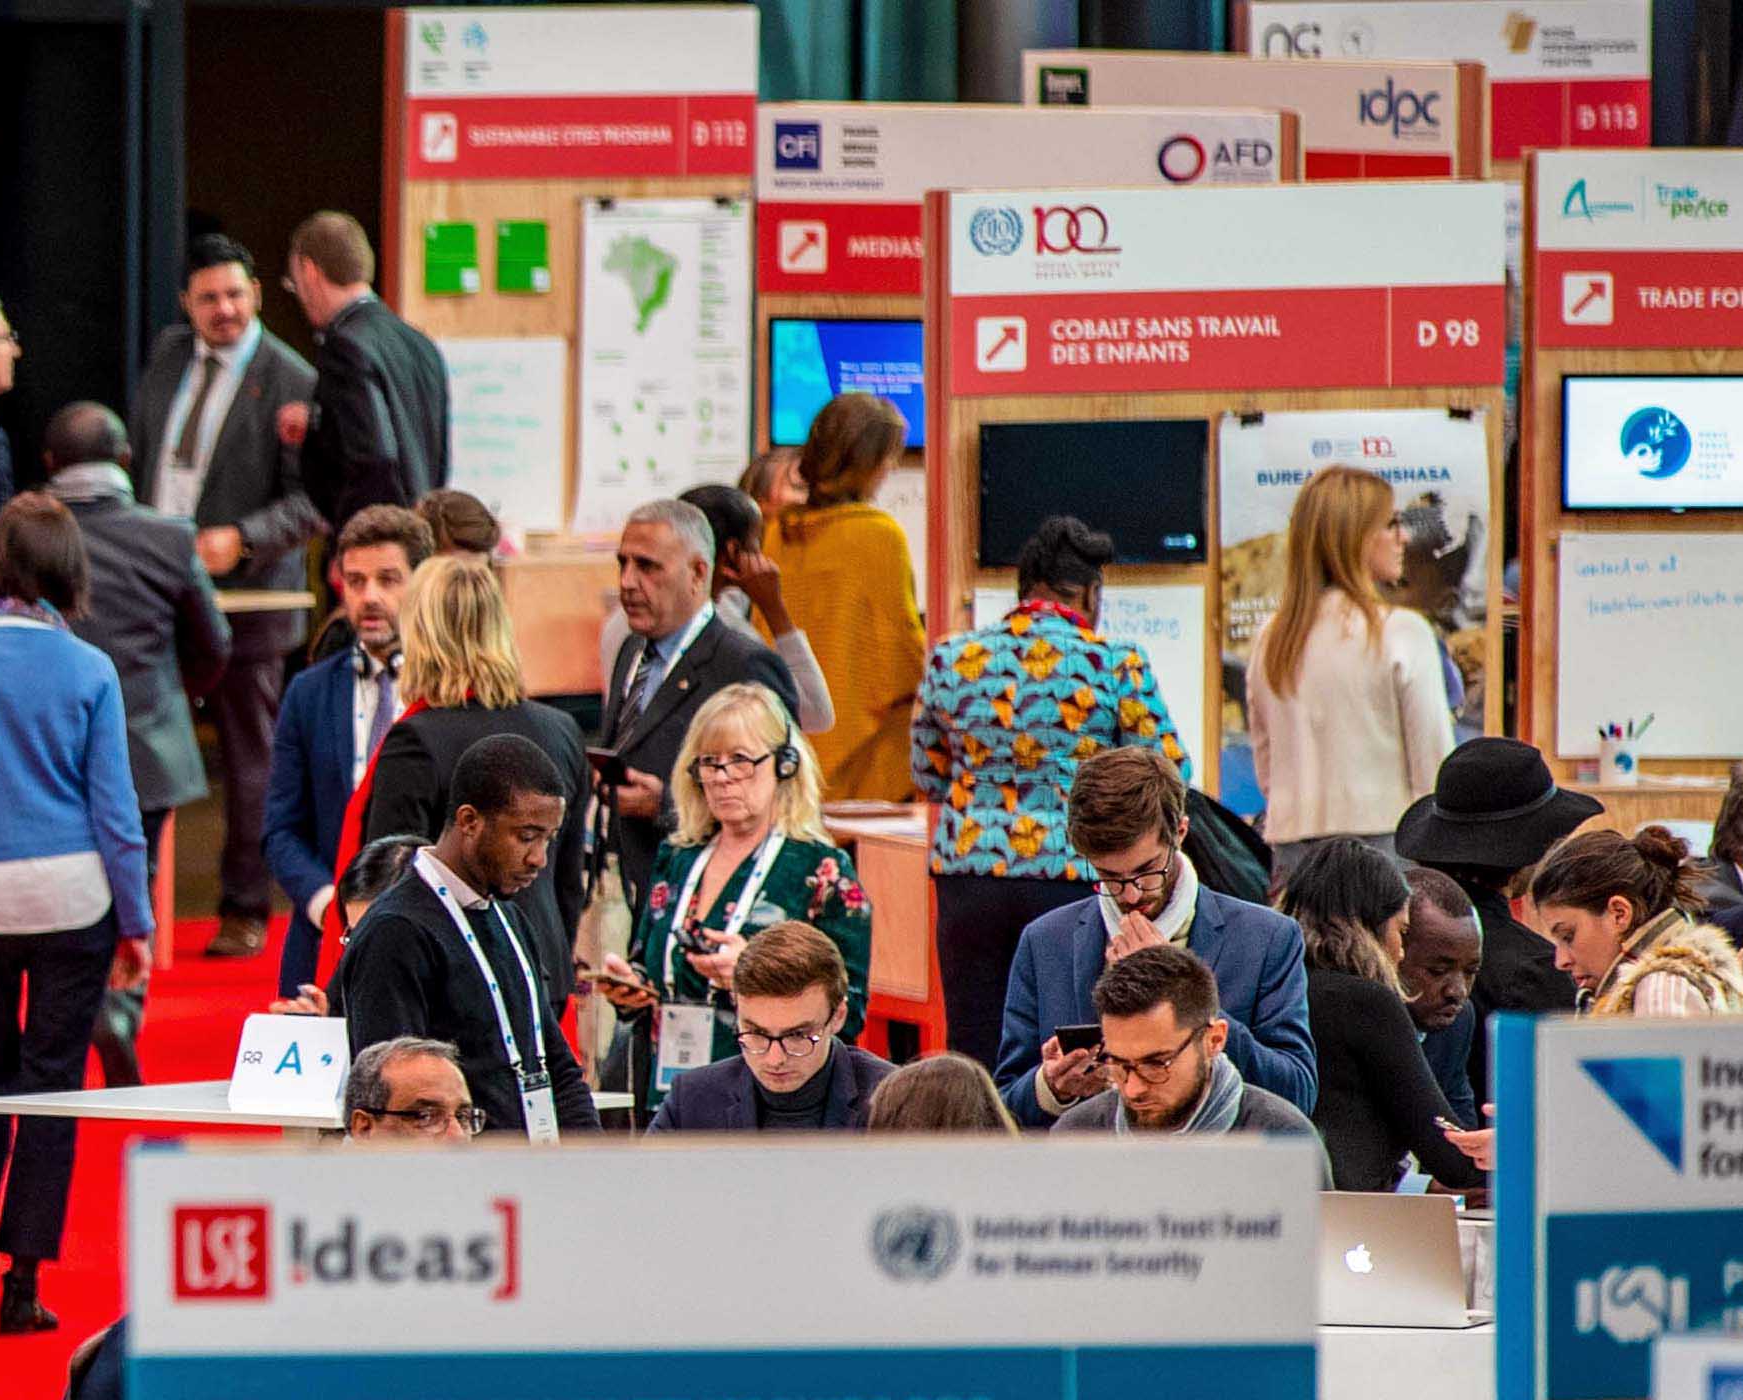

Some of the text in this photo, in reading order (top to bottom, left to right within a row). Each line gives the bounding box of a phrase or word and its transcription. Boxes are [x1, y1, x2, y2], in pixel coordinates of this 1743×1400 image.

[1578, 104, 1639, 131] D 113
[1214, 142, 1273, 168] AFD
[1638, 286, 1743, 309] TRADE FO
[1051, 315, 1281, 342] COBALT SANS TRAVAIL
[1417, 320, 1480, 347] D 98
[1051, 340, 1190, 365] DES ENFANTS
[274, 1041, 303, 1075] A
[1220, 1211, 1282, 1239] Fund
[180, 1213, 258, 1290] LSE
